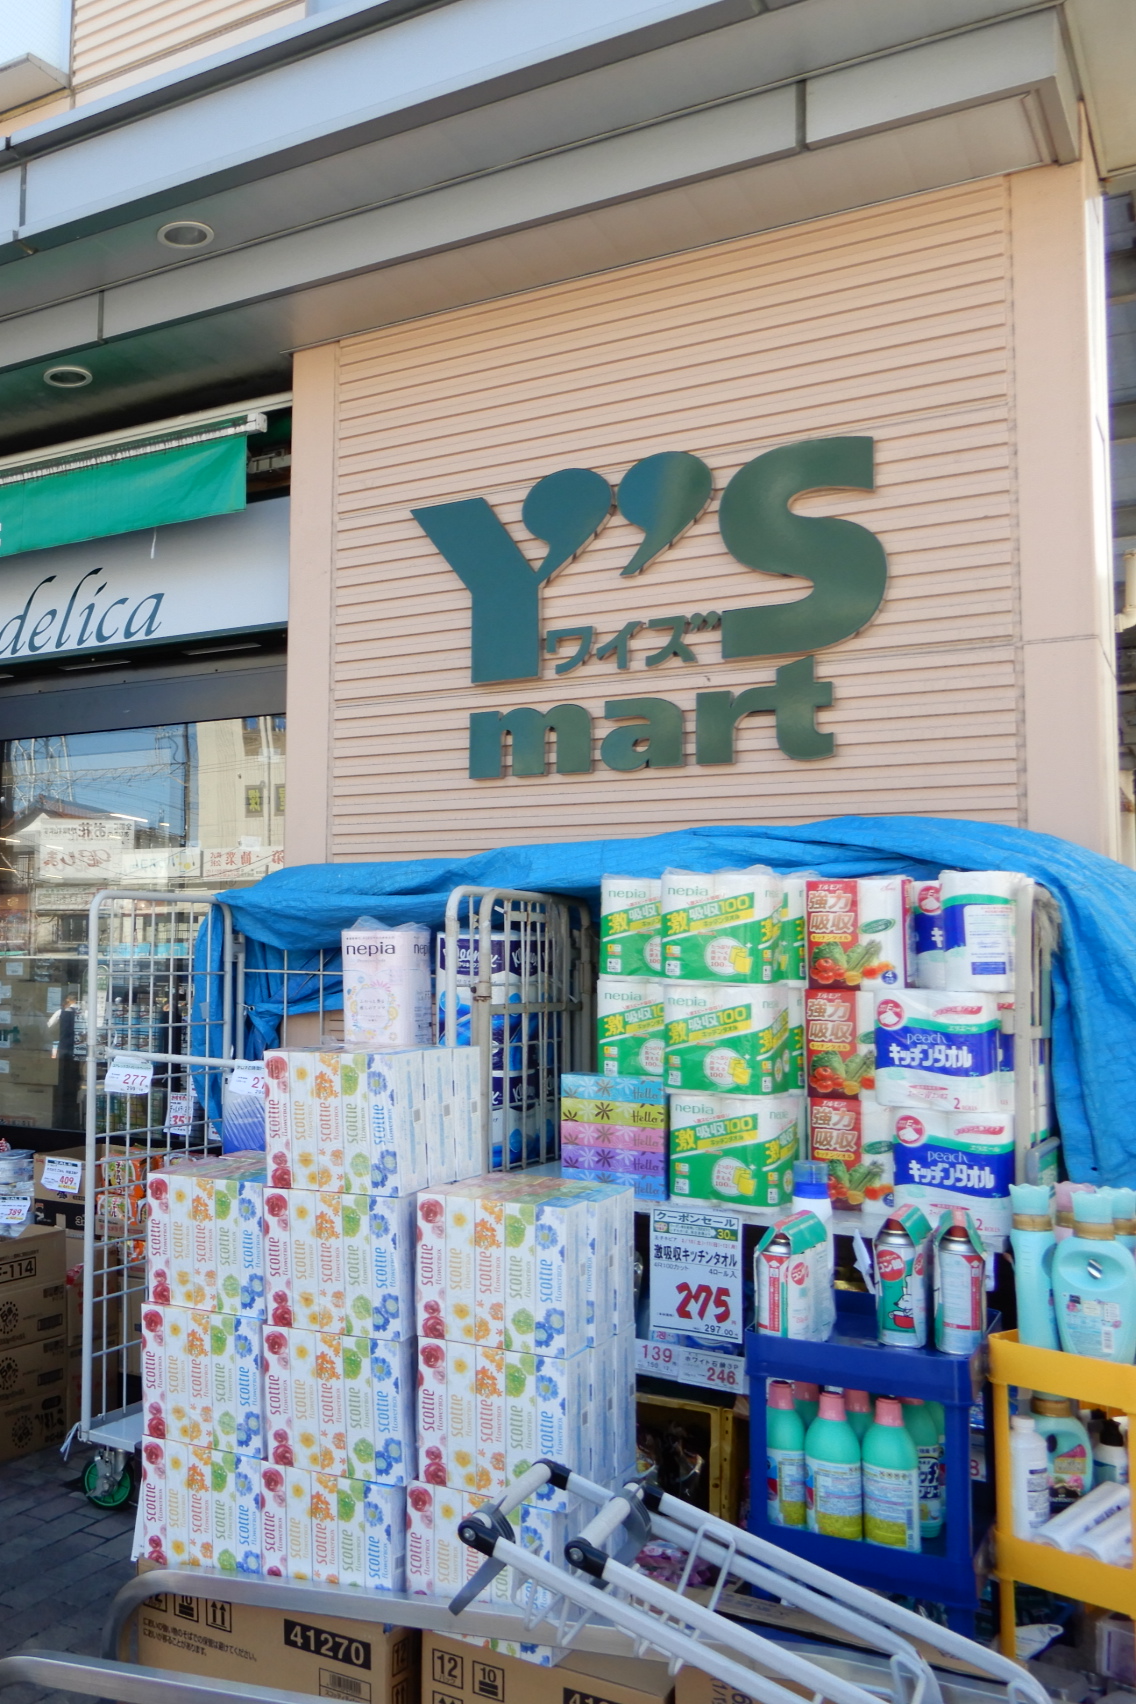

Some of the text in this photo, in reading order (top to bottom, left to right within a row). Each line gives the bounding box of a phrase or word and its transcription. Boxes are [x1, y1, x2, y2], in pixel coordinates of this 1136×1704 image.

[546, 611, 723, 676] ワイズ
[469, 655, 834, 779] mart
[608, 888, 646, 900] nepia
[668, 886, 709, 897] nepia
[808, 891, 853, 911] 強力
[810, 912, 855, 932] 吸収
[346, 942, 395, 956] nepia
[605, 991, 642, 1001] nepia
[667, 996, 707, 1007] nepia
[807, 1000, 851, 1020] 強力
[809, 1022, 853, 1040] 吸収
[907, 1033, 947, 1044] peach
[889, 1043, 972, 1068] キッチンタオル
[122, 1073, 147, 1086] 277
[633, 1087, 658, 1099] Hello
[676, 1103, 714, 1114] nepia
[953, 1098, 961, 1109] 2
[631, 1110, 657, 1123] Hello
[812, 1108, 856, 1130] 強力
[634, 1134, 659, 1147] Hello
[814, 1130, 858, 1150] 吸収
[634, 1158, 659, 1171] Hello
[928, 1151, 968, 1162] peach
[59, 1176, 75, 1185] 409
[909, 1160, 995, 1189] キッチンタオル
[634, 1182, 659, 1195] Hello
[657, 1211, 735, 1228] クーポンセール
[975, 1219, 983, 1230] 2
[654, 1244, 737, 1267] 激吸収キッチンタオル
[675, 1281, 731, 1323] 275
[642, 1345, 672, 1363] 139
[707, 1367, 736, 1385] 246
[290, 1625, 365, 1665] 41270
[436, 1654, 458, 1679] 12
[480, 1667, 496, 1683] 10
